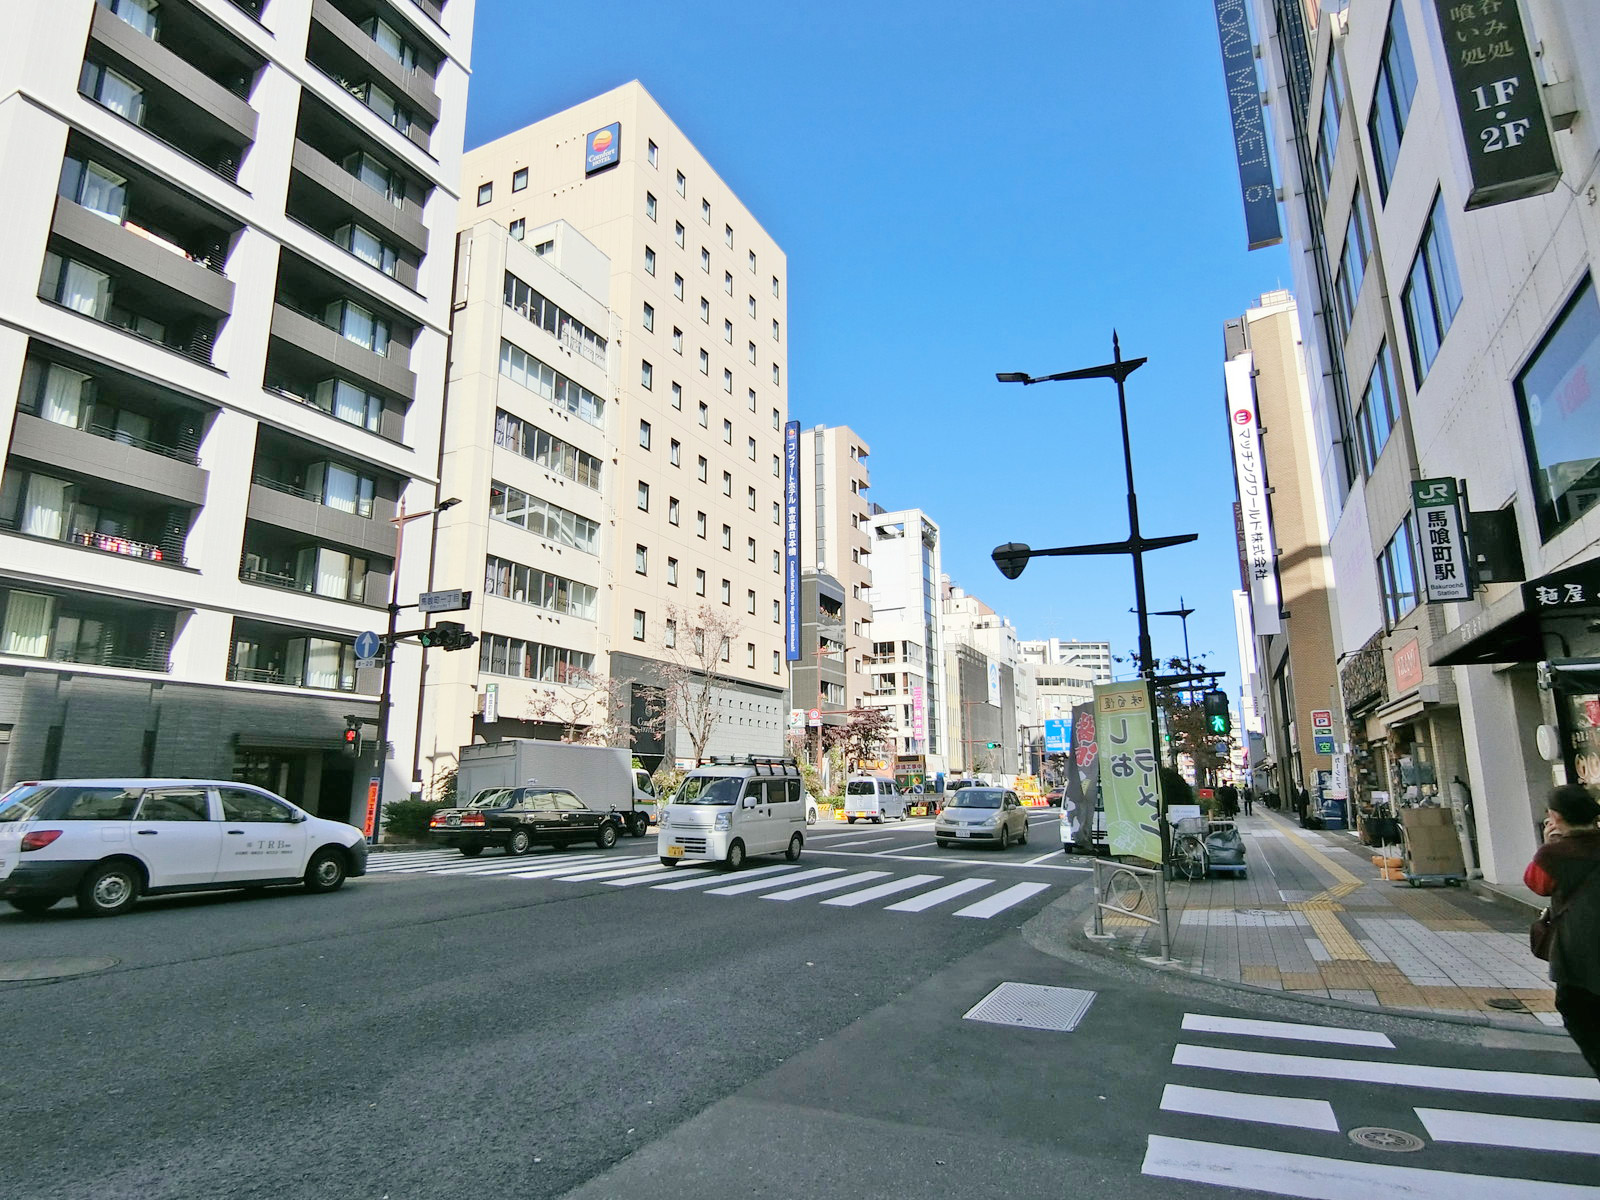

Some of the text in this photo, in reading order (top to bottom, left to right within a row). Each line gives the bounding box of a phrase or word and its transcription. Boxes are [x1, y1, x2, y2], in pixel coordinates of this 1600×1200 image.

[1471, 76, 1519, 112] 1F
[1228, 67, 1268, 168] MARKET
[1480, 117, 1530, 154] 2F
[588, 148, 615, 163] Comfort
[592, 155, 612, 167] HOTEL
[1245, 184, 1272, 204] 6
[788, 443, 797, 557] コンフォートホテル 東京東日本橋
[1239, 428, 1268, 581] マッチングワールド株式会社
[1418, 483, 1449, 499] JR
[1427, 510, 1456, 581] 馬喰町駅
[1437, 589, 1460, 597] Station
[258, 840, 285, 849] TRB
